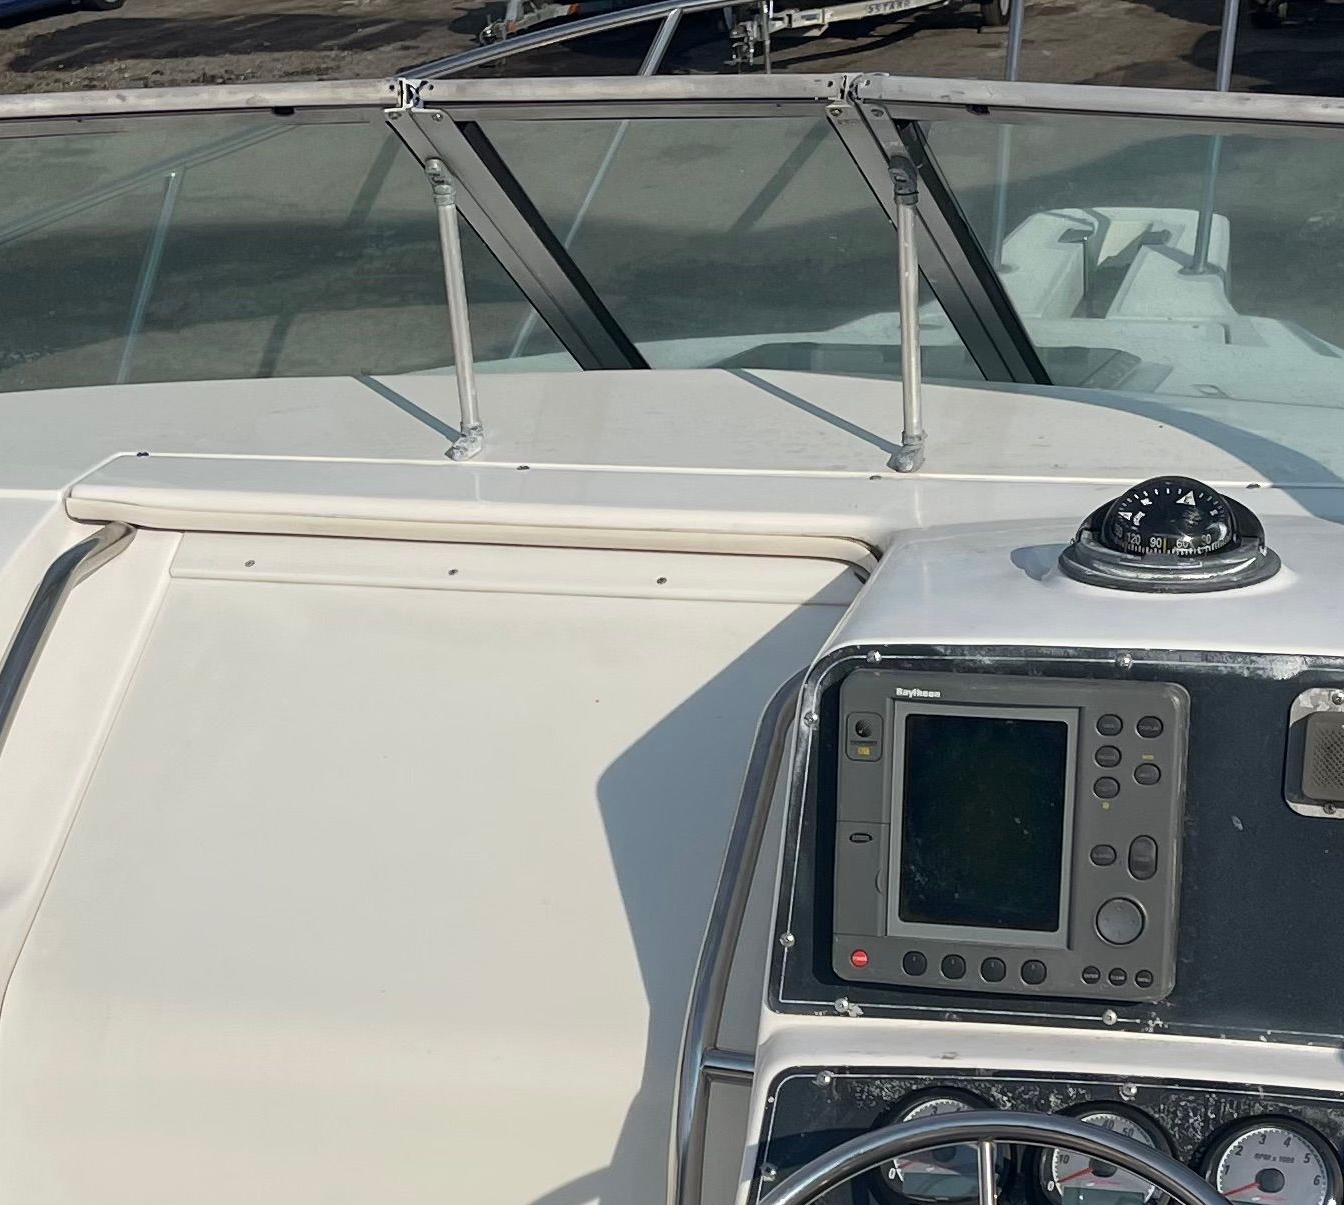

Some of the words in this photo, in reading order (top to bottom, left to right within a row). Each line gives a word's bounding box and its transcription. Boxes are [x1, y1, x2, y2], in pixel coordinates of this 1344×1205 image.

[1150, 537, 1162, 548] 90
[1259, 1134, 1267, 1145] 3
[1284, 1137, 1292, 1147] 4
[1235, 1145, 1244, 1156] 2
[1059, 1154, 1070, 1164] 10
[1304, 1153, 1311, 1163] 5
[1313, 1175, 1321, 1185] 6
